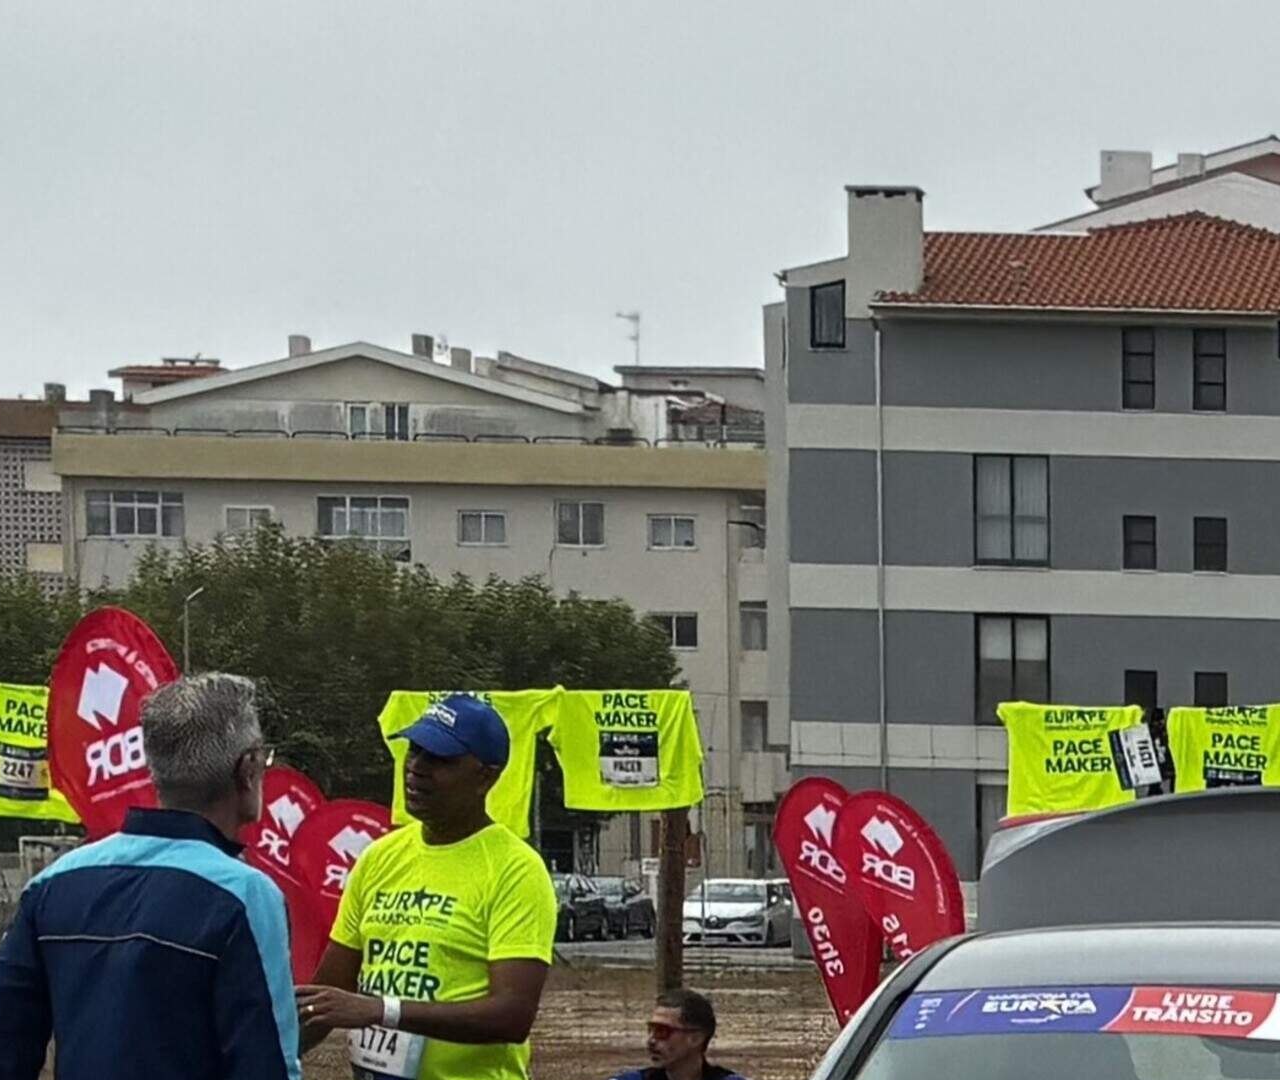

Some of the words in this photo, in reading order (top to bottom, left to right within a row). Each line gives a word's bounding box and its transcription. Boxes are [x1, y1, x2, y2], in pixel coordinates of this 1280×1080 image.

[6, 699, 45, 720] PAC
[602, 693, 648, 709] PACE
[595, 711, 657, 728] MAKER
[1053, 739, 1102, 756] PACE
[1212, 733, 1260, 751] PACE
[1045, 757, 1112, 773] MAKER
[1203, 750, 1267, 770] MAKER
[3, 761, 34, 778] 2247
[368, 939, 429, 969] PACE
[1162, 992, 1236, 1010] LIVRE
[1132, 1006, 1254, 1026] TRÂNSITO
